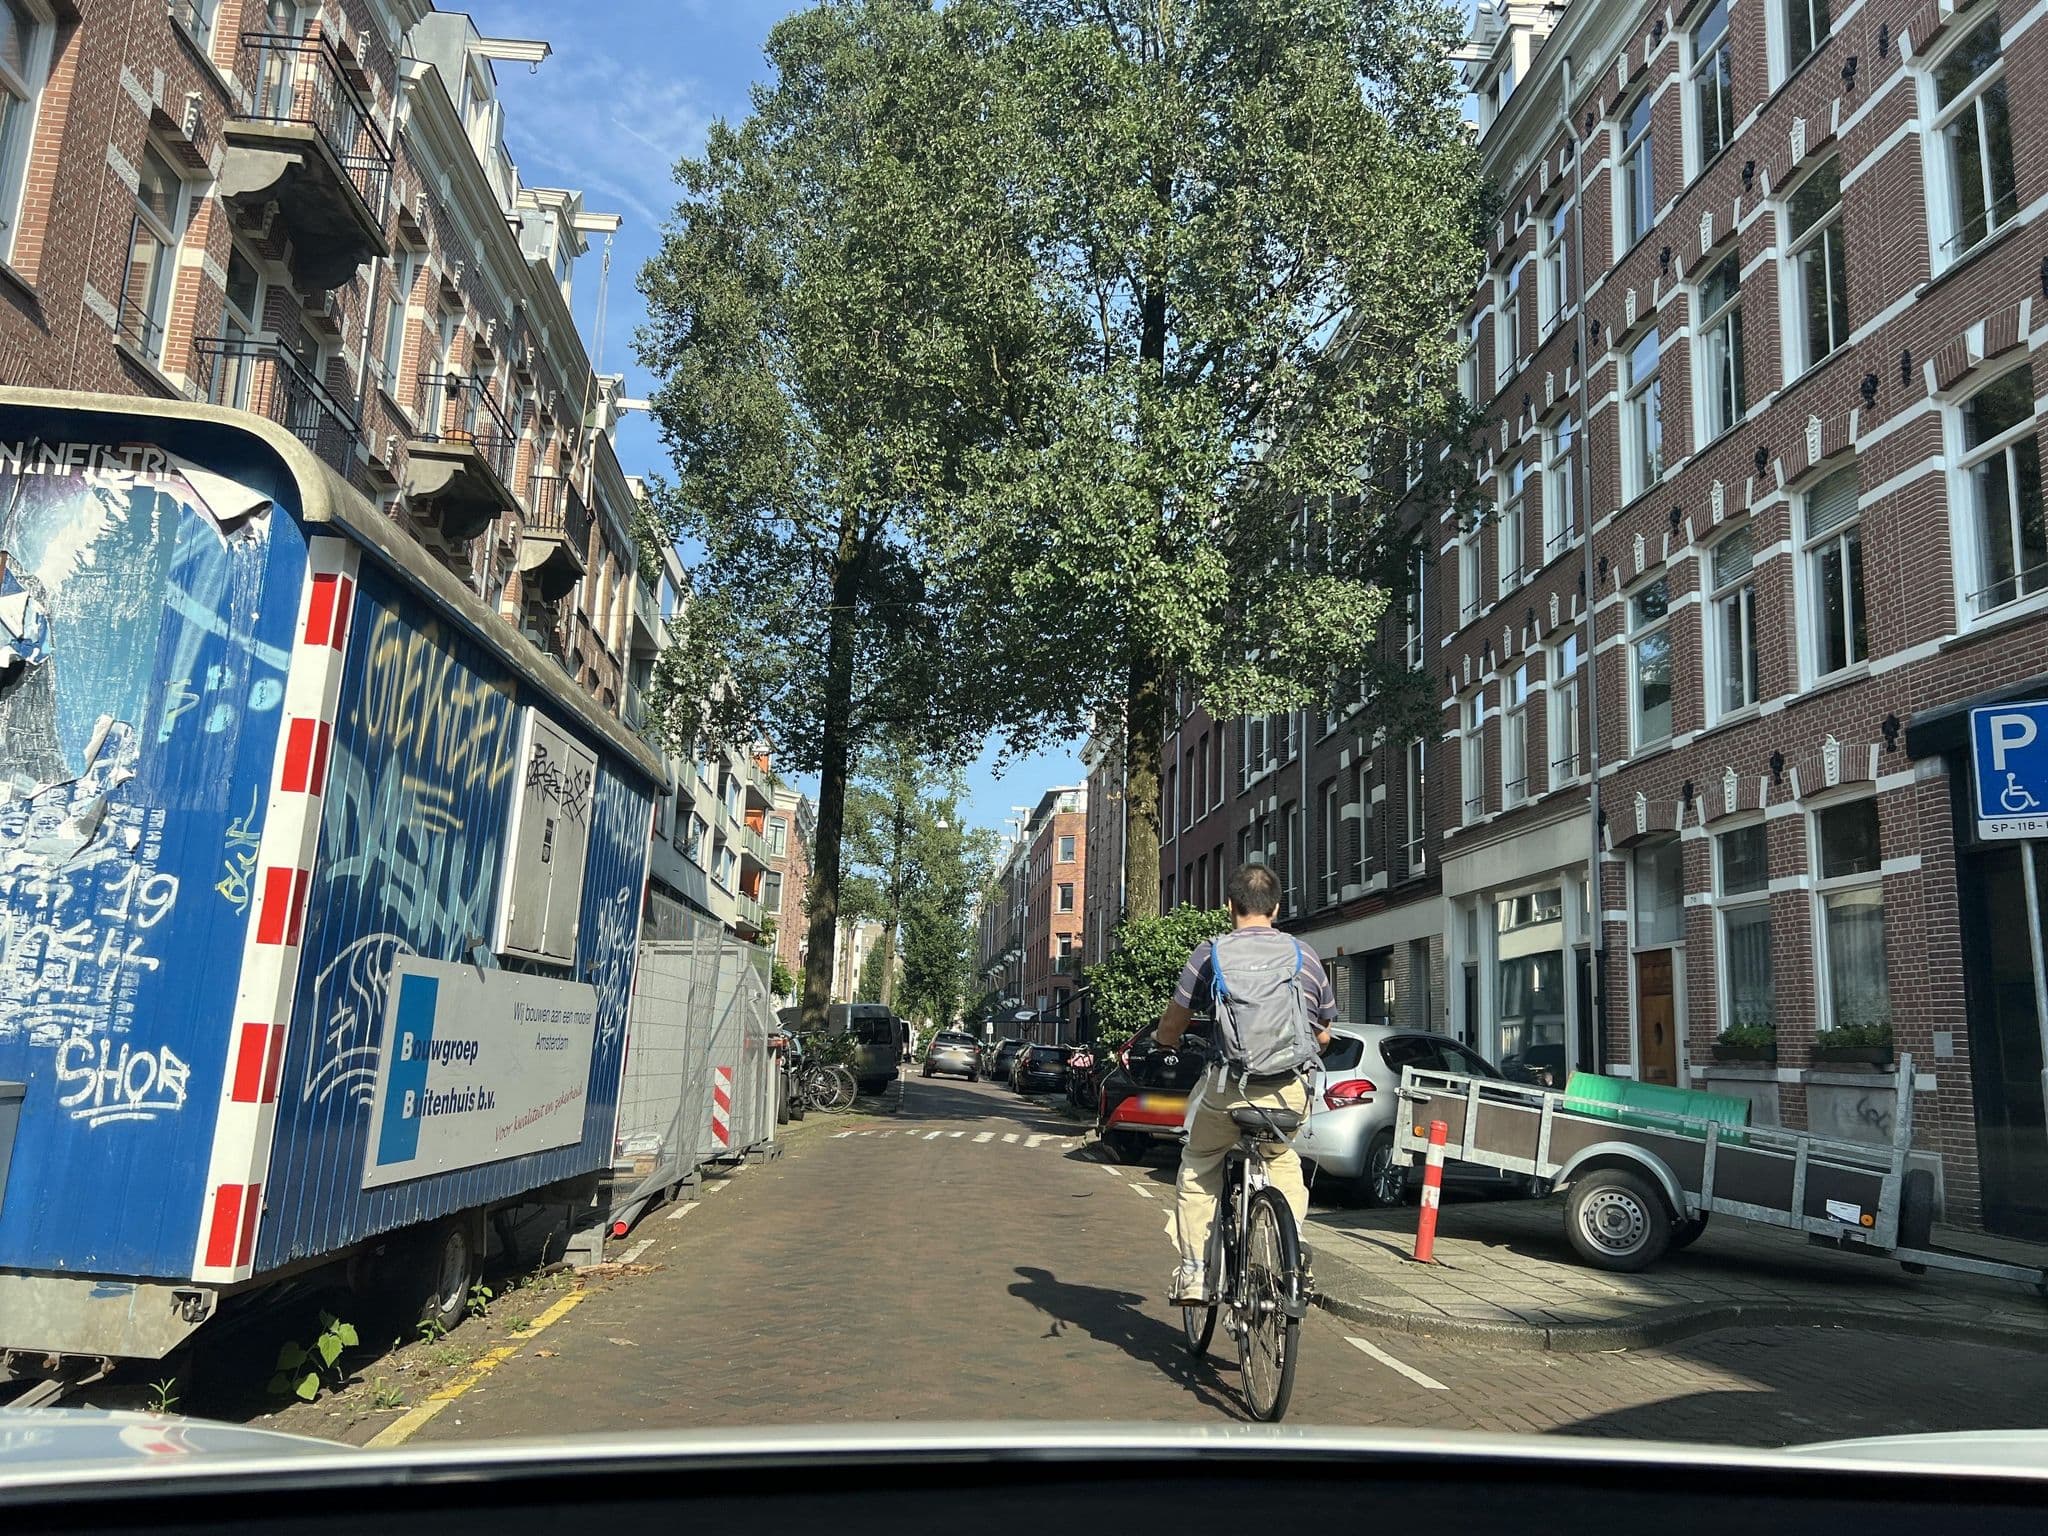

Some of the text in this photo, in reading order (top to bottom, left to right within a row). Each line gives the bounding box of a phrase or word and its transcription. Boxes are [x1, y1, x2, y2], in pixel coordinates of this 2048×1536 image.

[1990, 713, 2038, 771] P
[1991, 821, 2048, 833] SP-118-
[513, 1000, 525, 1025] Wij
[526, 1002, 550, 1023] bouwen
[551, 1009, 562, 1023] aan
[563, 1010, 574, 1024] een
[400, 1031, 479, 1067] Bouwgroep
[535, 1032, 569, 1051] Amsterdam
[402, 1084, 495, 1119] Buitenhuis b.v.
